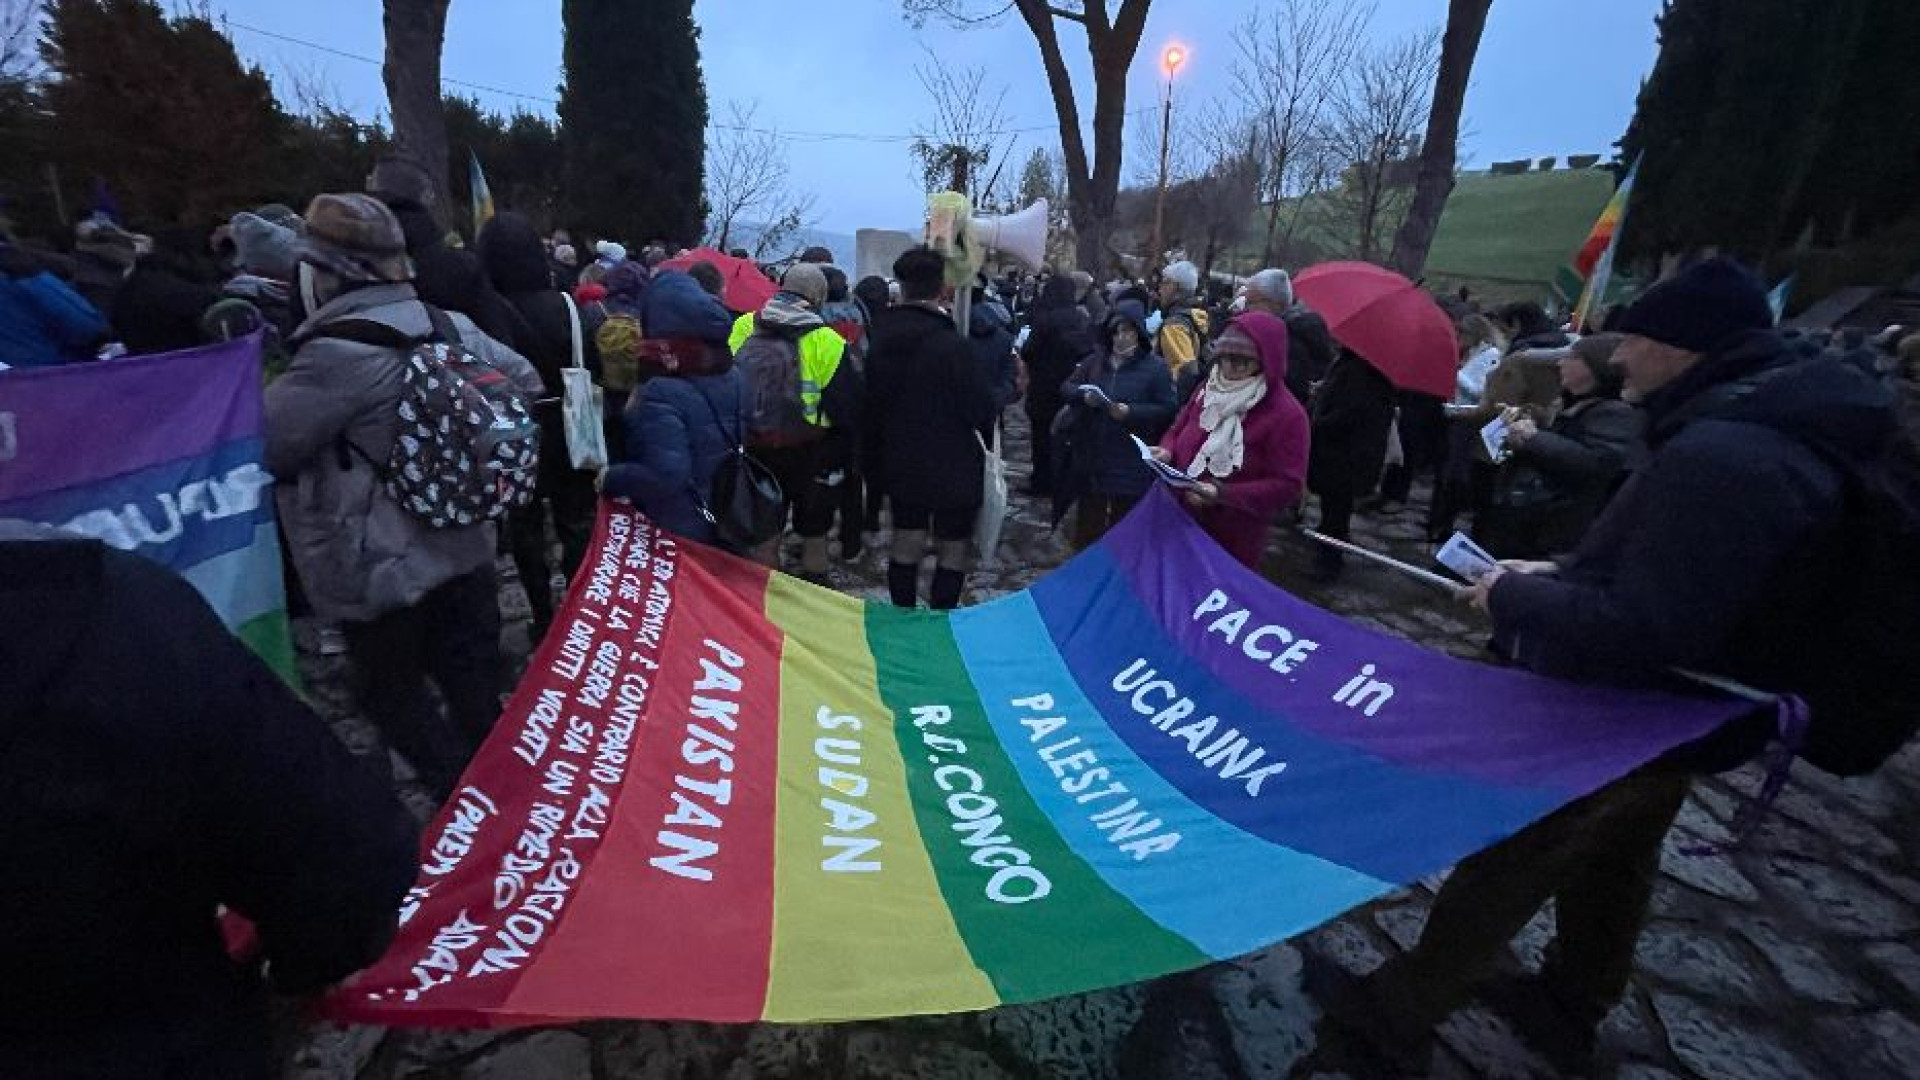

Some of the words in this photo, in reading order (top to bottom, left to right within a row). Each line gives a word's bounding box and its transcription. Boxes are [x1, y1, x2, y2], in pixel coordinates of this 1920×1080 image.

[552, 619, 595, 681] DIRITTI
[580, 607, 601, 619] I
[609, 605, 632, 629] LA
[576, 642, 622, 708] GUERRA
[1193, 588, 1319, 674] PACE
[1333, 664, 1393, 716] in
[513, 689, 566, 765] VIOLATI
[560, 716, 593, 753] SIA
[591, 673, 649, 783] CONTRARIO
[650, 639, 746, 882] PAKISTAN
[1113, 659, 1286, 796] UCRAINA
[543, 761, 579, 794] UN
[564, 784, 609, 839] ALLA
[816, 705, 882, 873] SUDAN
[1012, 694, 1179, 858] PALESTINA
[494, 802, 566, 908] RIMEDIO
